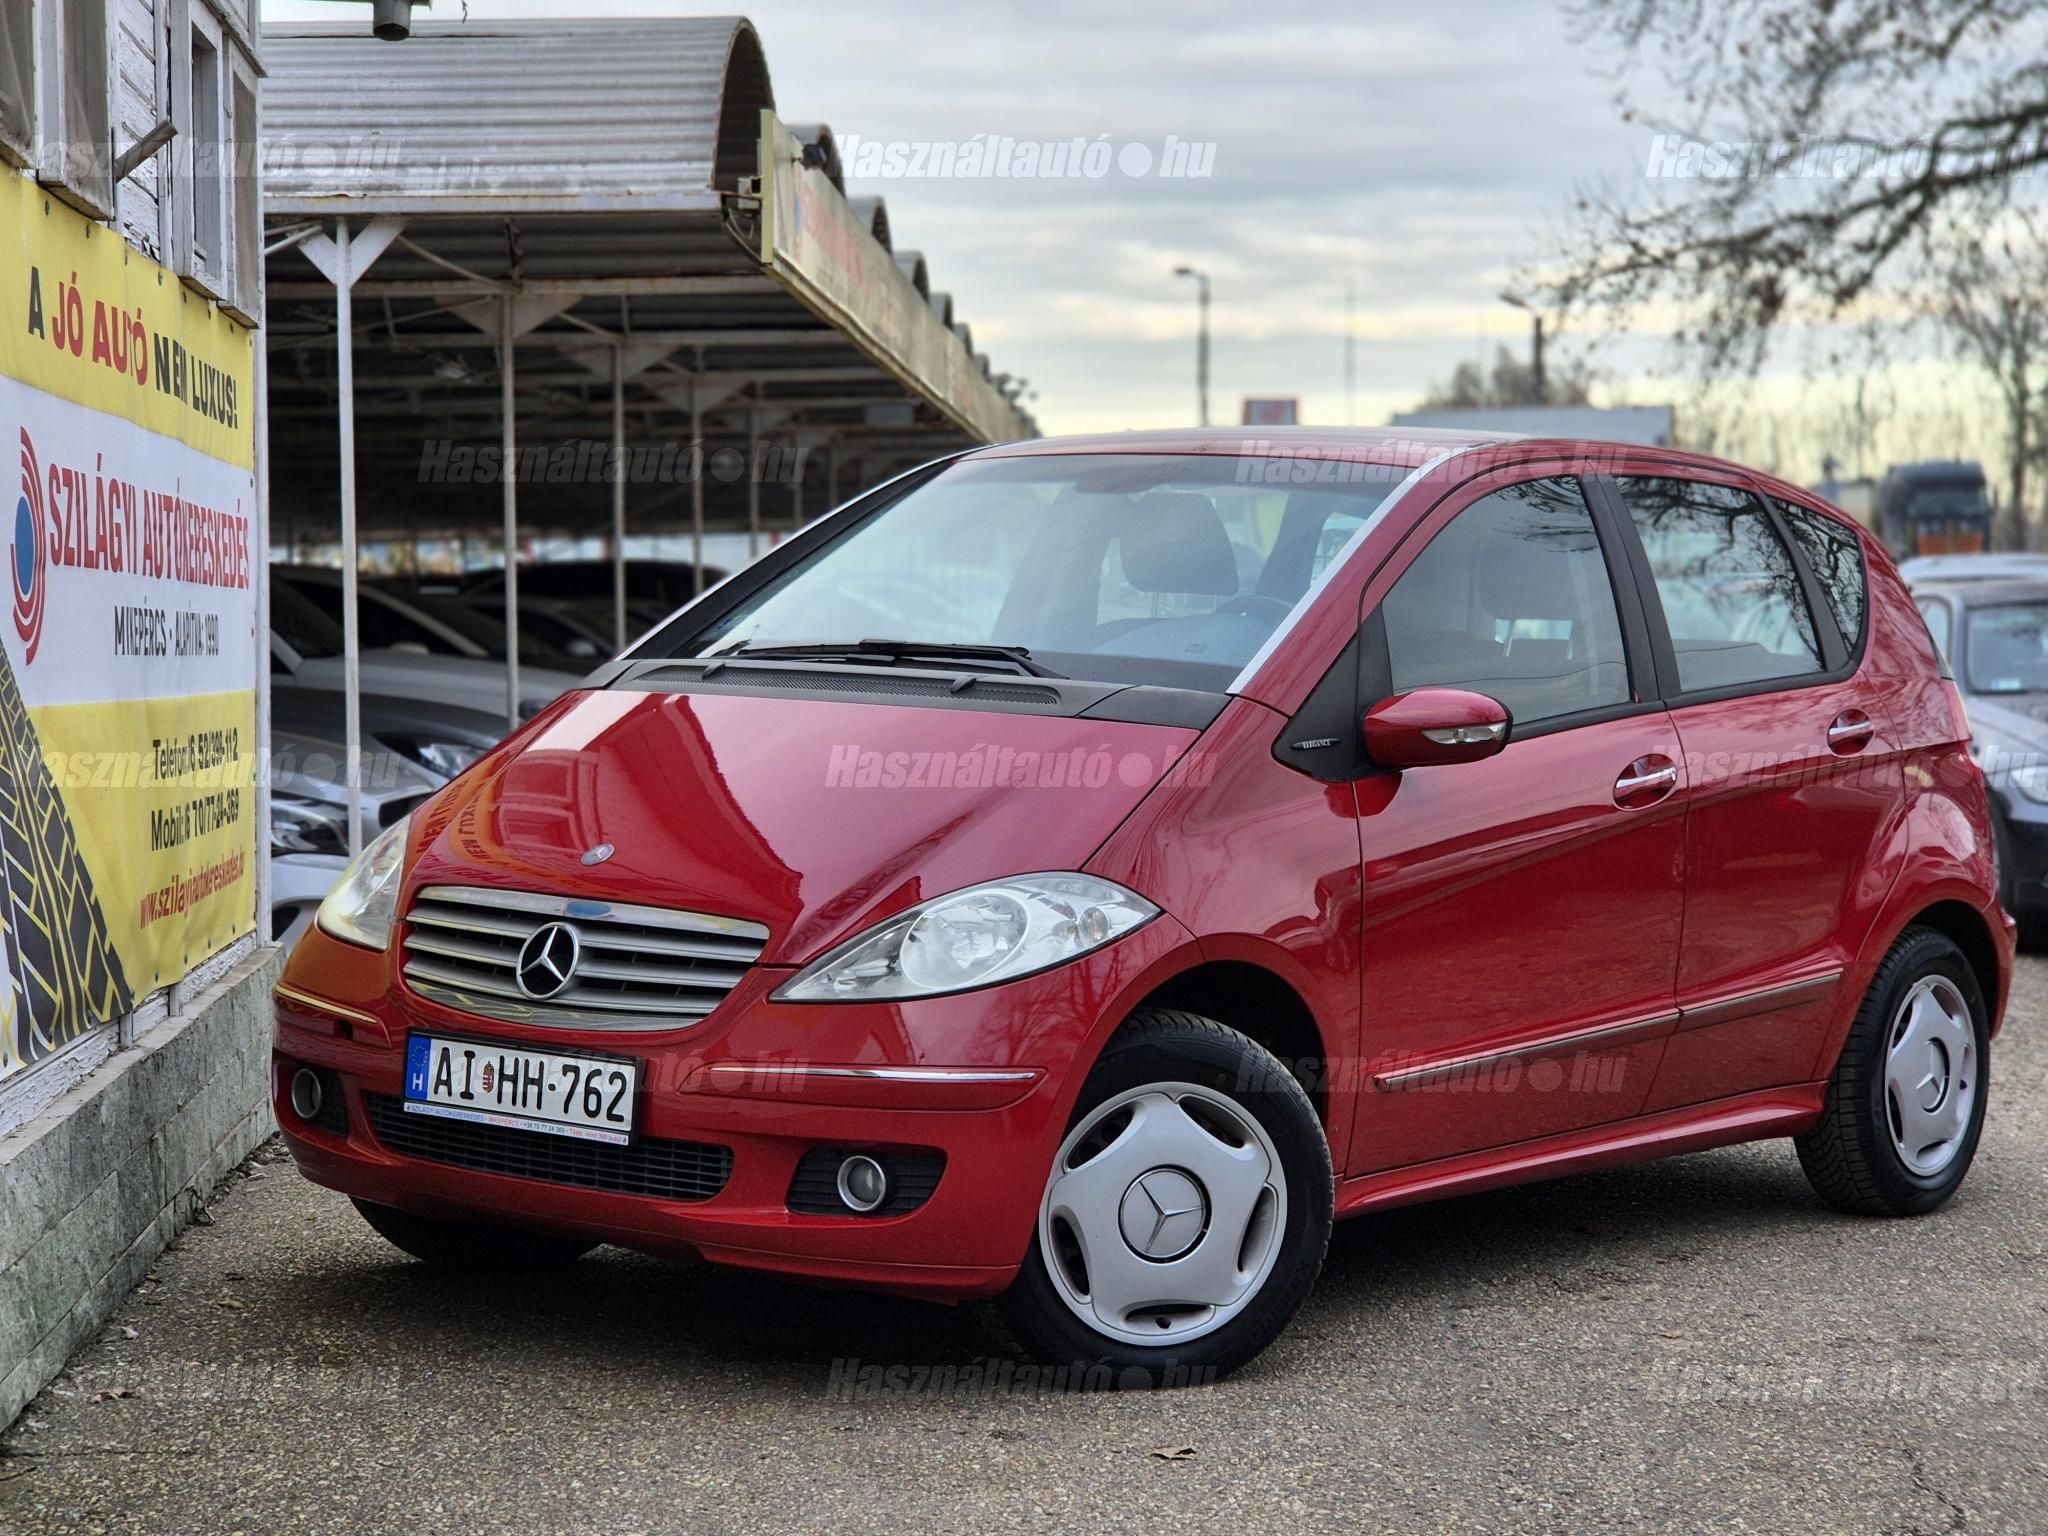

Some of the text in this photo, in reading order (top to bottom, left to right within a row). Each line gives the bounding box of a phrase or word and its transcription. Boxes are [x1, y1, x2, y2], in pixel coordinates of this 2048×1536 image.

[28, 266, 45, 340] A
[52, 271, 84, 358] JÓ
[154, 333, 188, 405] NEM
[191, 355, 239, 430] LUXUS!
[49, 452, 250, 590] SZILÁGYI AUTÓKERESKEDÉS
[412, 1072, 423, 1092] H
[433, 1046, 628, 1123] AI HH-762
